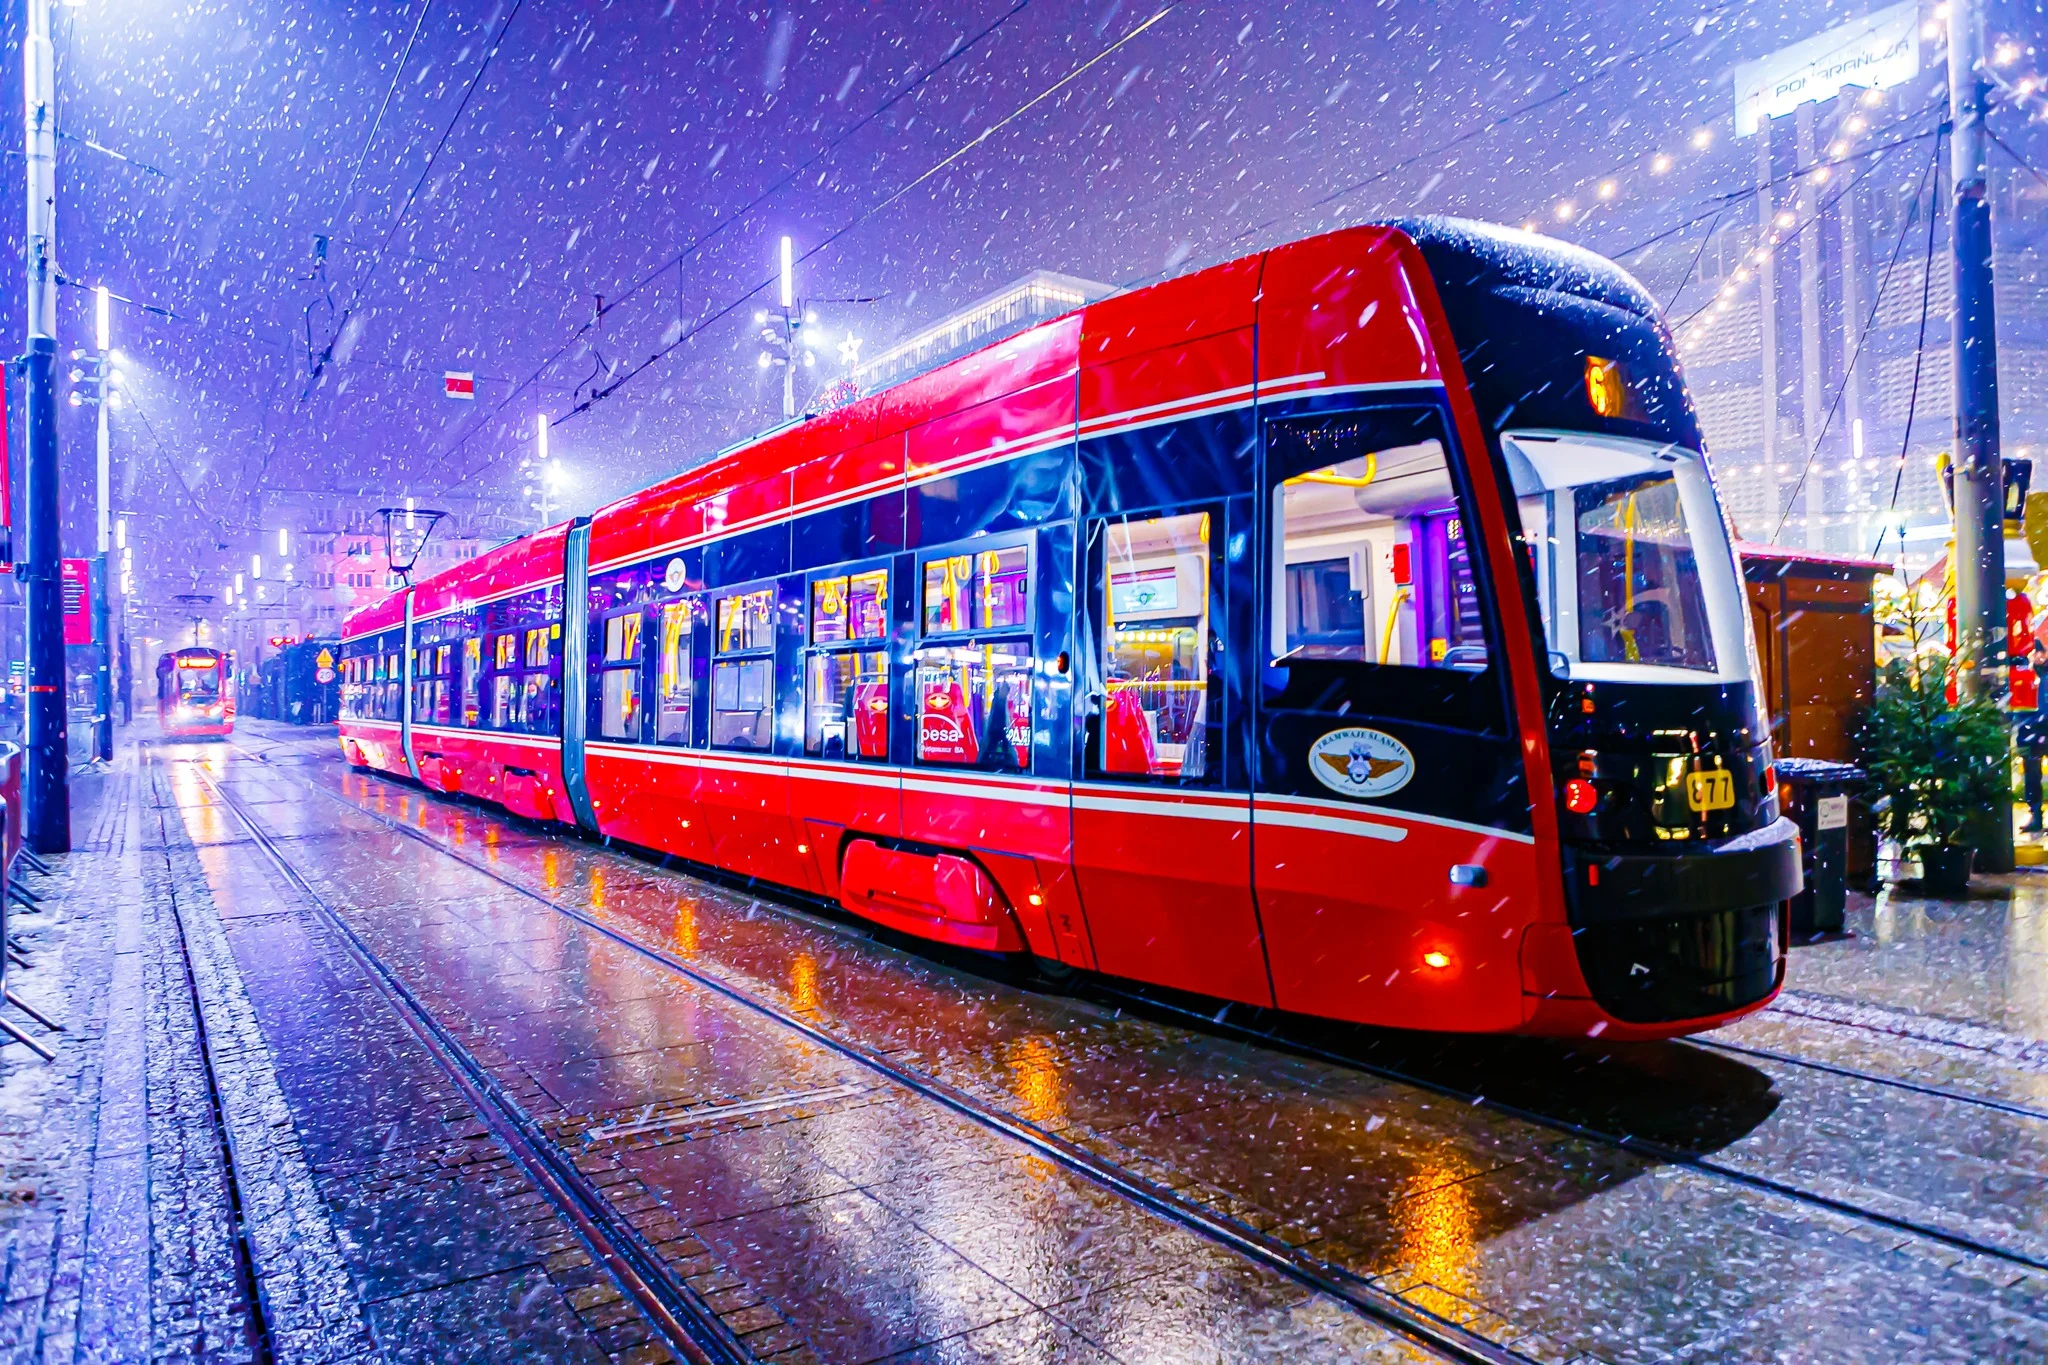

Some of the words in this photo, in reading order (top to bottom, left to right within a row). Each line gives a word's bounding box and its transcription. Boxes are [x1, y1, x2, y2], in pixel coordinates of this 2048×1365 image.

[1590, 366, 1606, 413] 6
[921, 728, 959, 744] pesa
[1317, 730, 1366, 750] TRAMWAJE
[1691, 776, 1730, 804] 877
